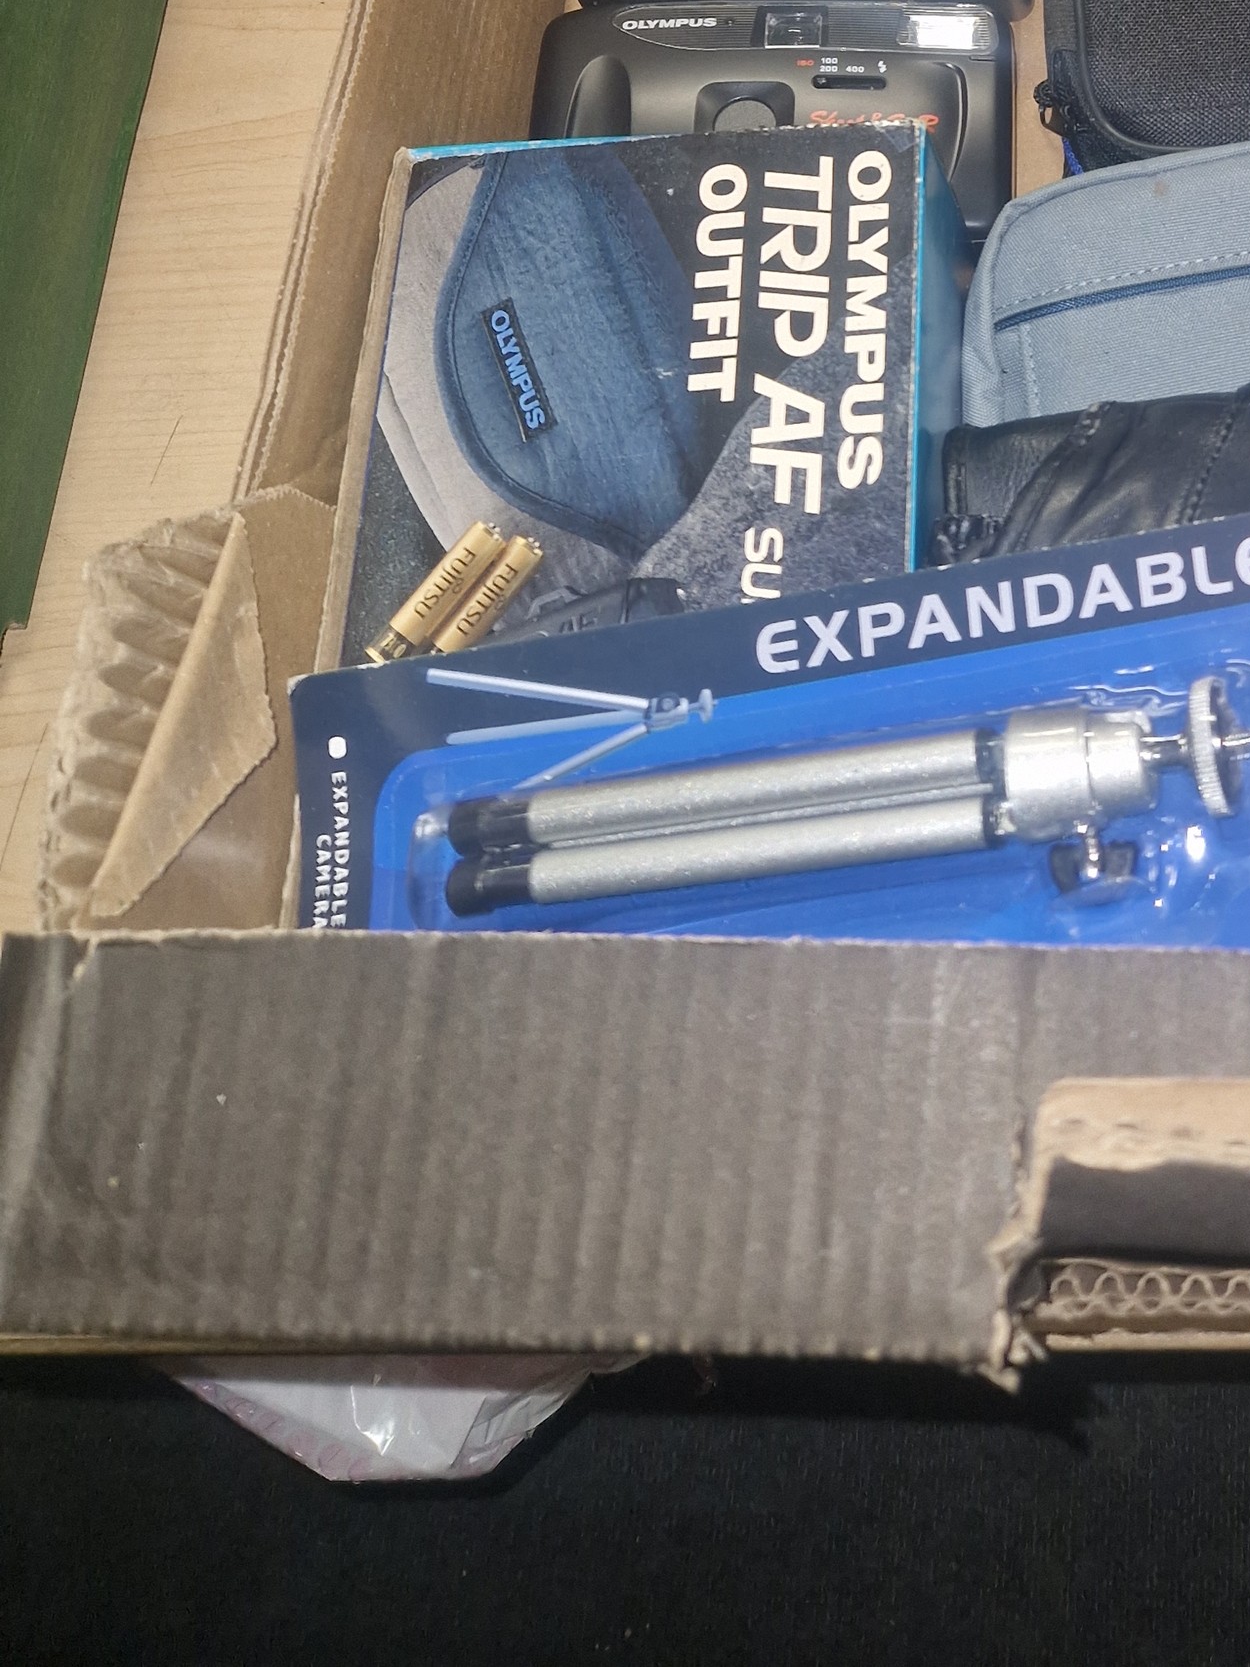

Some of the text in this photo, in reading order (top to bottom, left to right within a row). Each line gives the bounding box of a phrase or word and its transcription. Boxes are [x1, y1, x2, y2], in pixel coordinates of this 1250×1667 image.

[622, 16, 718, 31] OLYMPUS
[819, 65, 838, 73] 200
[687, 163, 749, 403] OUTFIT
[837, 150, 893, 490] OLYMPUS
[490, 309, 547, 431] OLYMPUS
[739, 156, 835, 604] TRIP AF SU
[413, 547, 476, 620] FUJITSU
[456, 563, 519, 636] FUJITSU
[312, 834, 332, 928] CAMERA
[330, 771, 350, 928] EXPANDABLE
